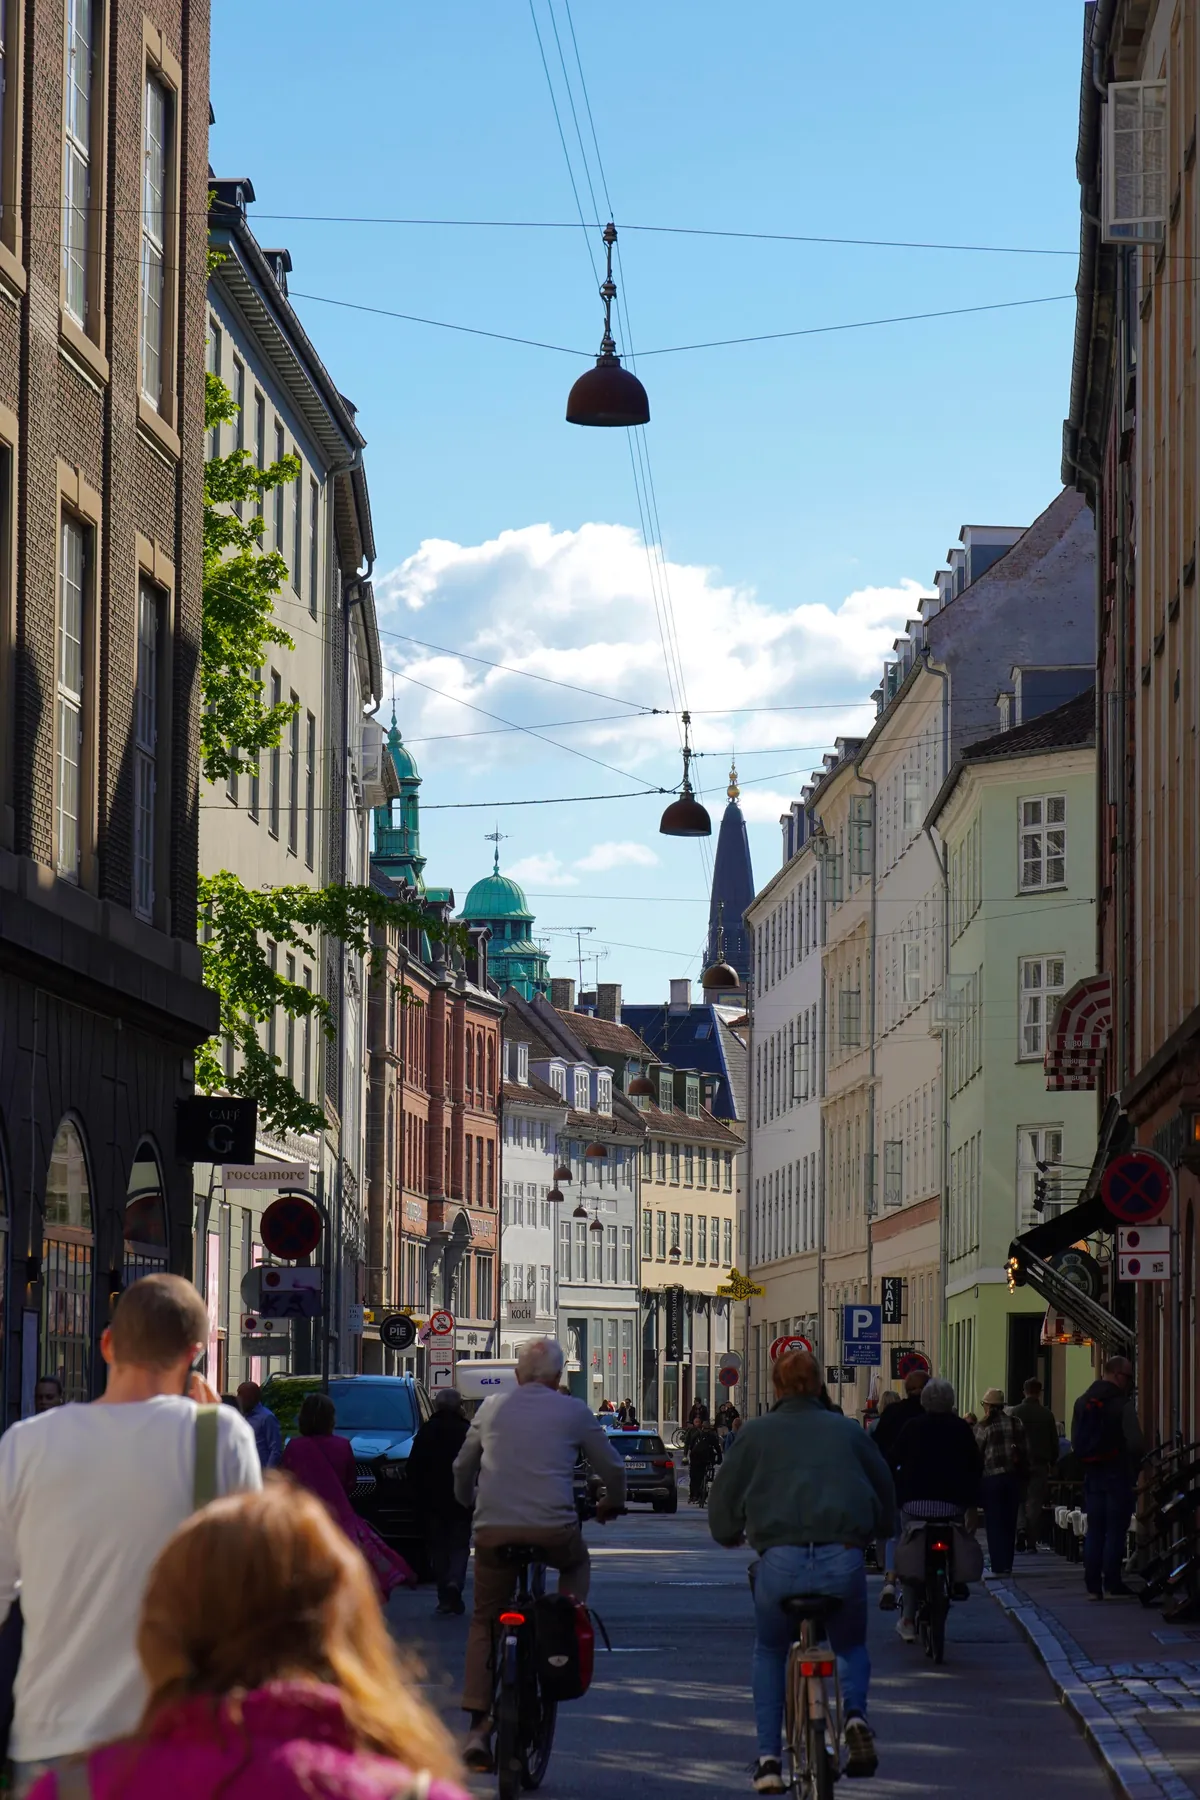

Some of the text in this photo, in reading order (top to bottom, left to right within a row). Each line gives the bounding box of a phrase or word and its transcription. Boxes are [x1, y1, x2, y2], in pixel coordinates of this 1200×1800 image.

[208, 1124, 235, 1154] G
[511, 1309, 531, 1319] KOCH
[885, 1279, 894, 1322] KANT
[389, 1327, 407, 1336] PIE
[852, 1309, 873, 1338] P
